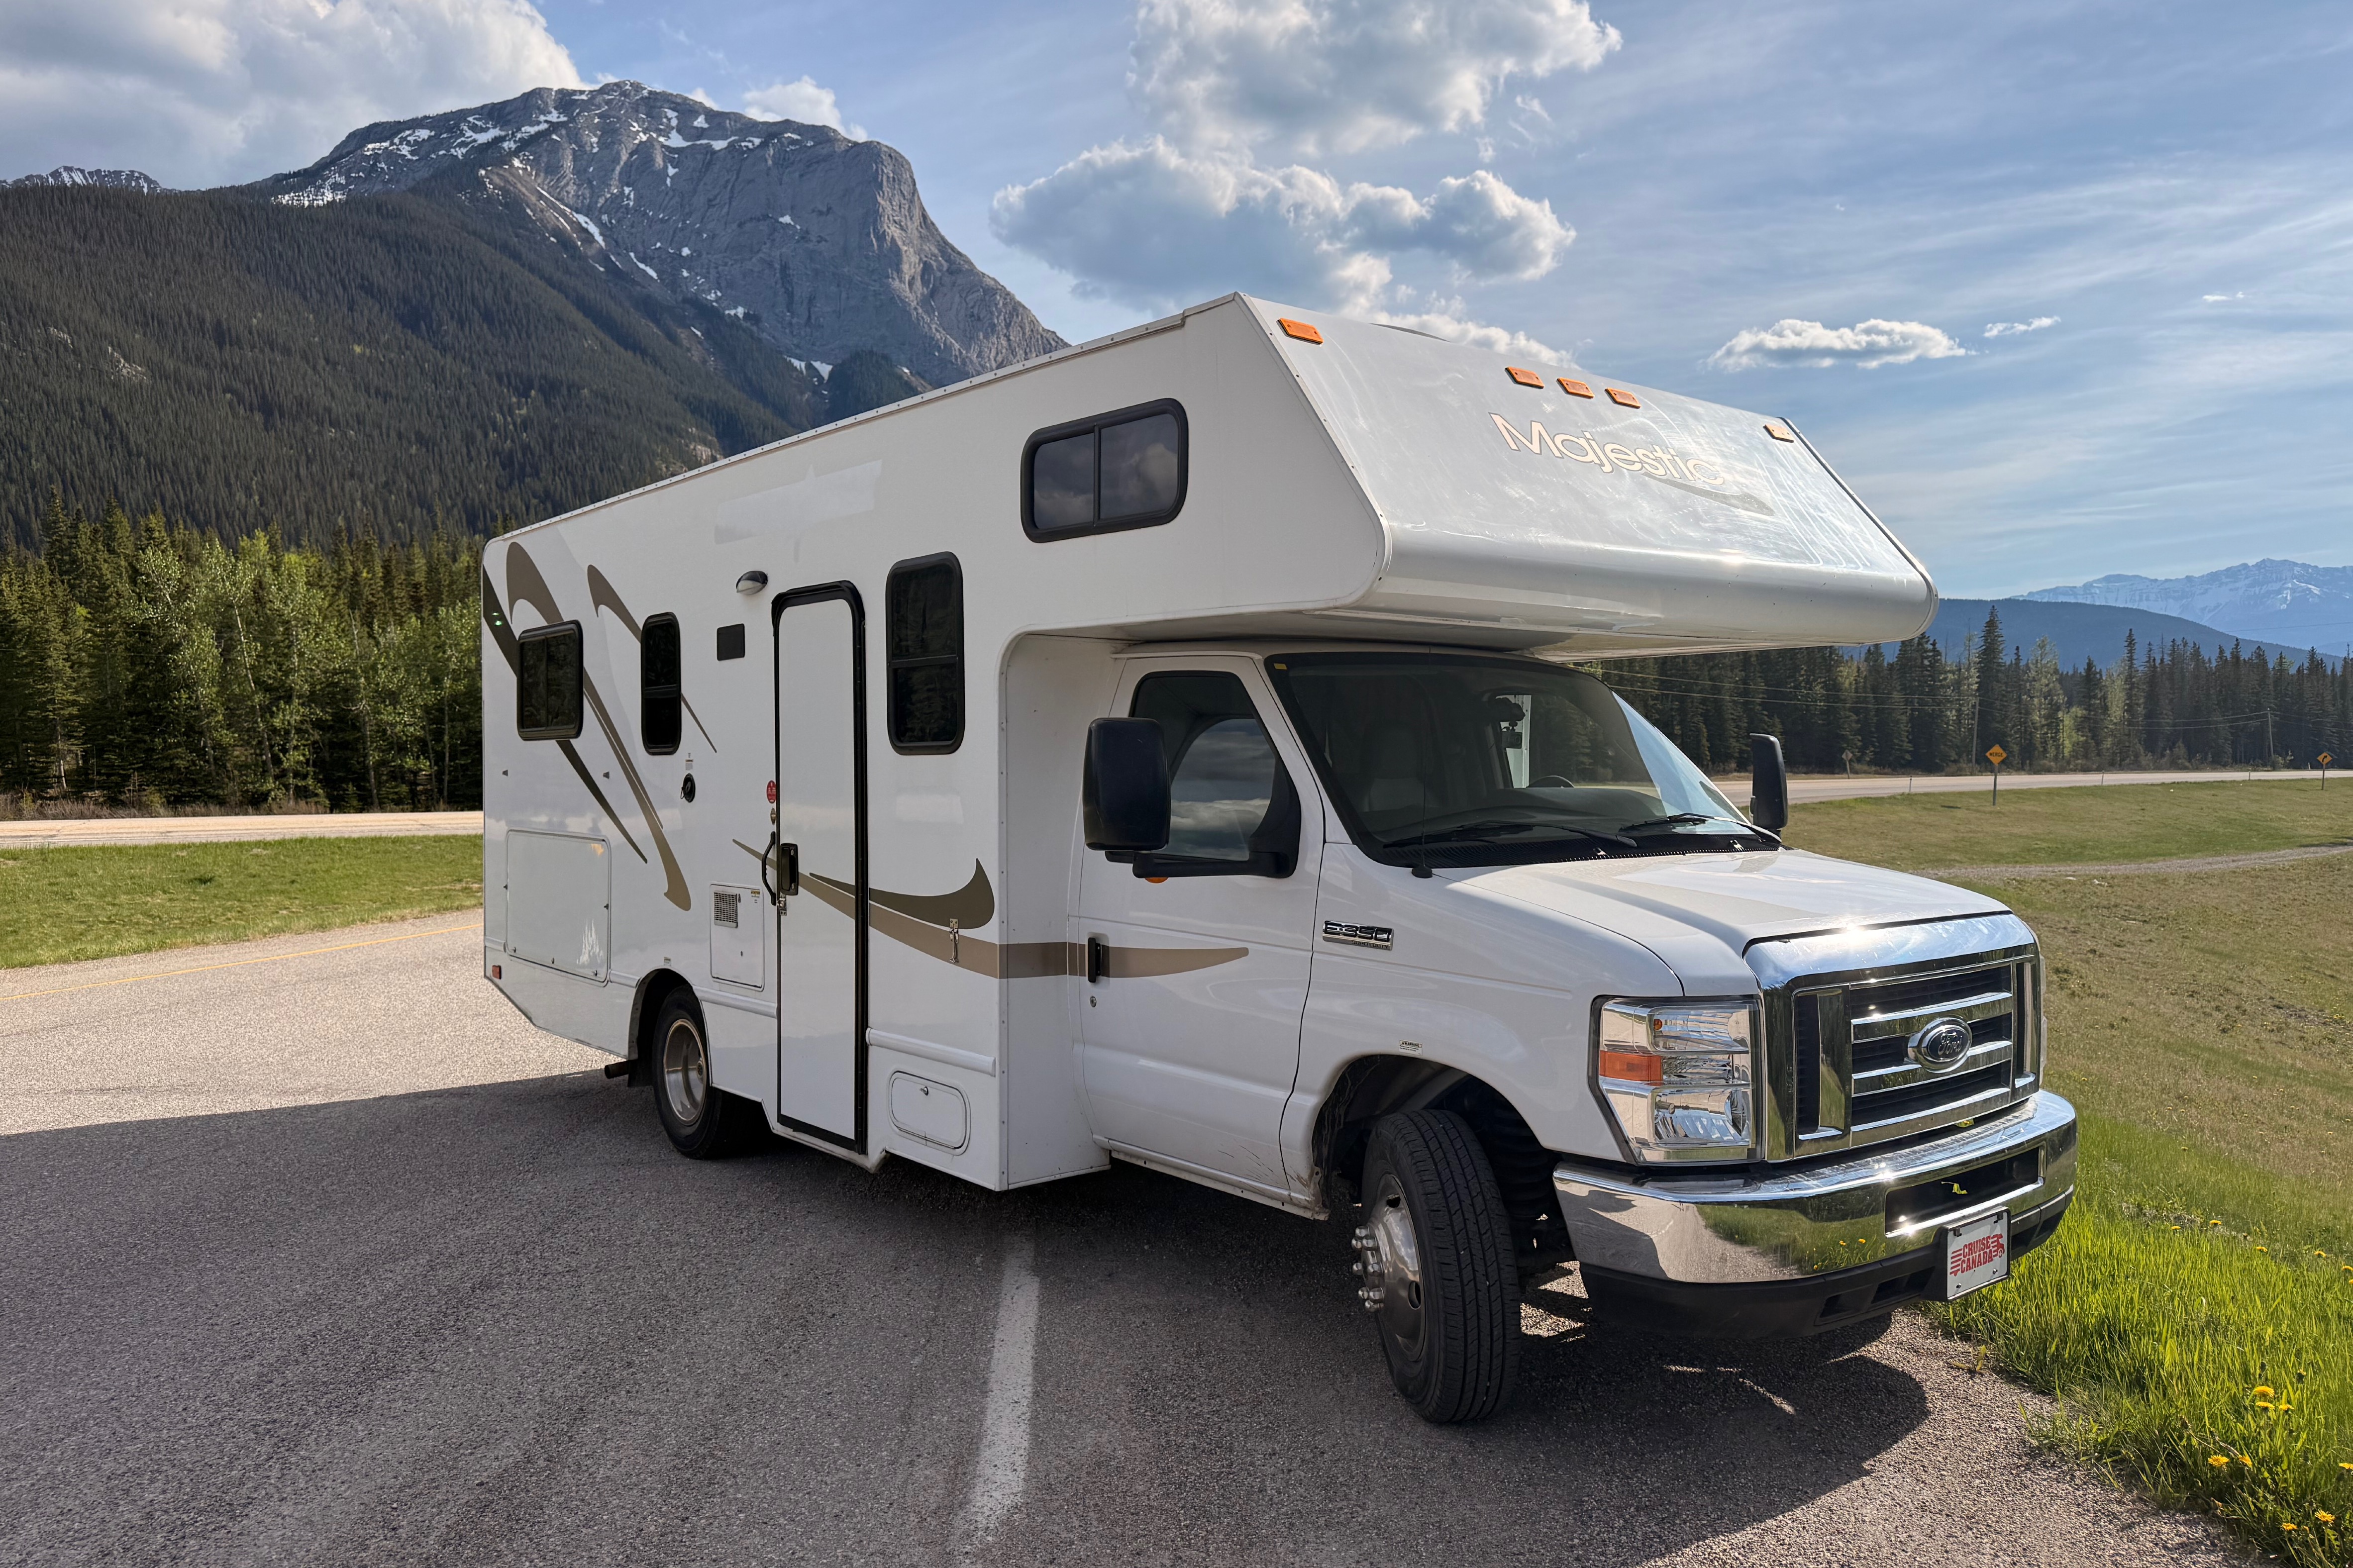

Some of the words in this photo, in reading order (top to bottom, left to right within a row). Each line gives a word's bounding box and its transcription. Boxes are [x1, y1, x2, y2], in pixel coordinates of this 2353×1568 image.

[1488, 412, 1726, 486] Majestic
[1938, 1032, 1962, 1056] Ford
[1962, 1236, 1991, 1259] CRUISE
[1960, 1249, 1993, 1274] CANADA
